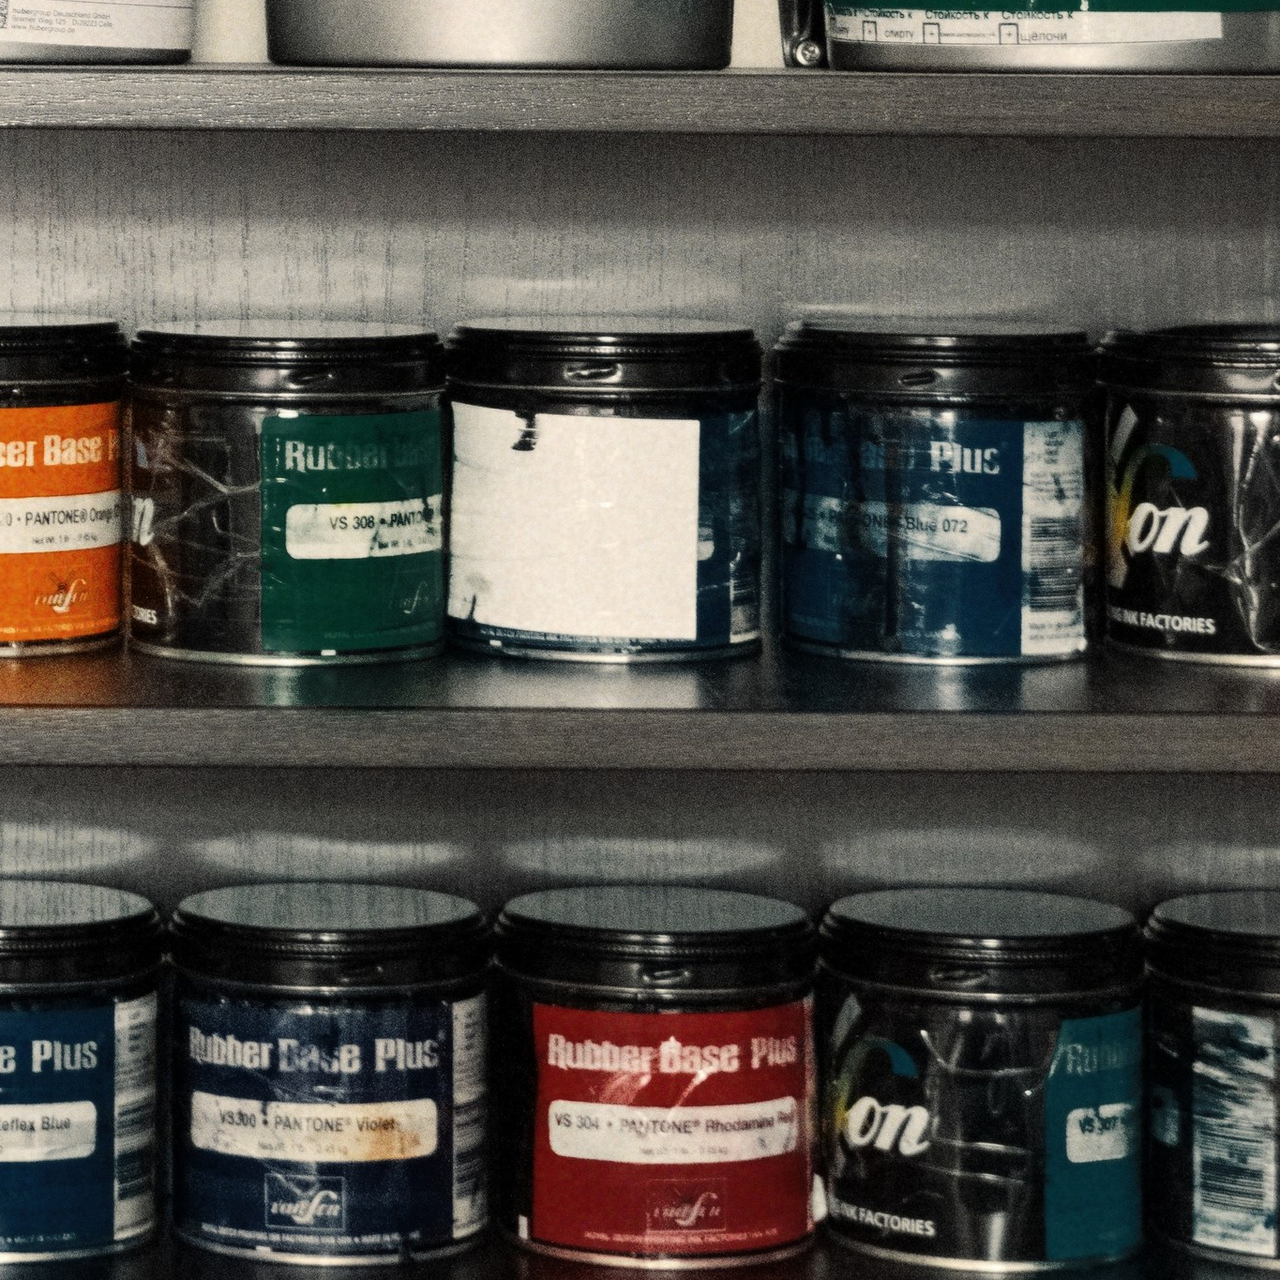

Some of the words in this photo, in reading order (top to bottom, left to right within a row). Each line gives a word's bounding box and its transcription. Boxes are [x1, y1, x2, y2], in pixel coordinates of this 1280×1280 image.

[330, 517, 348, 530] VS
[942, 520, 968, 533] 072
[32, 1040, 98, 1073] Plus
[41, 1117, 71, 1130] Blue
[356, 1115, 396, 1132] Violet
[577, 1115, 599, 1130] 304
[859, 1207, 936, 1237] FACTORIES
